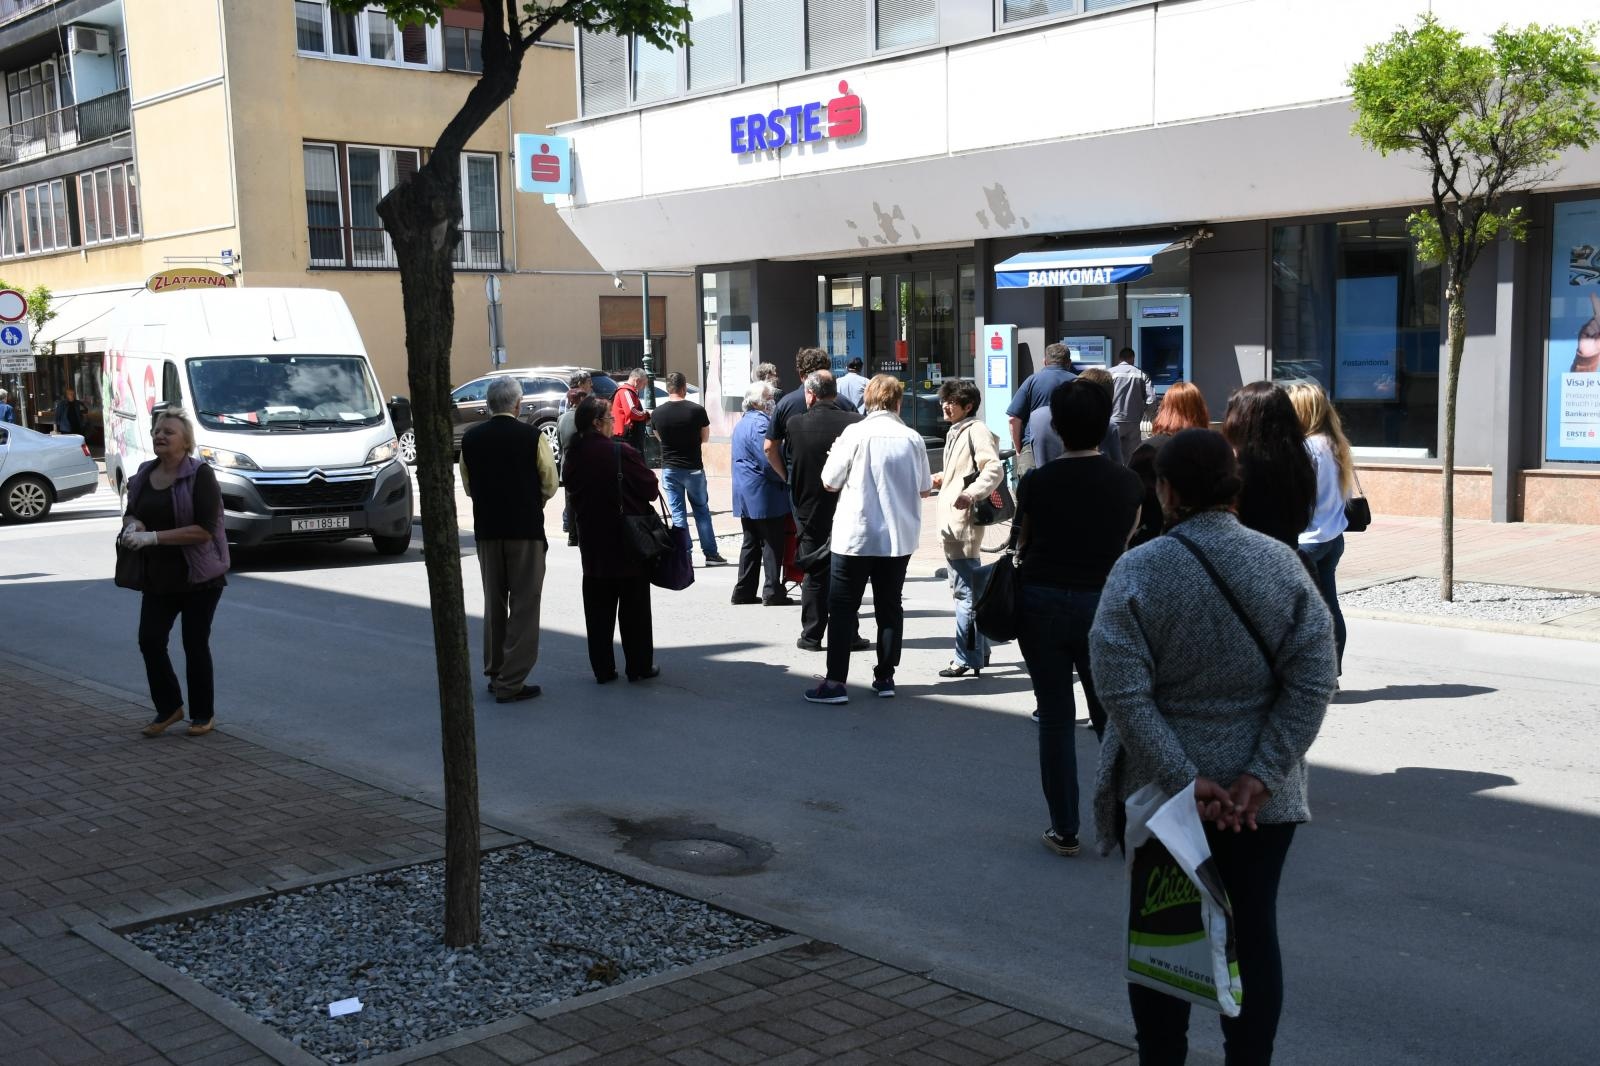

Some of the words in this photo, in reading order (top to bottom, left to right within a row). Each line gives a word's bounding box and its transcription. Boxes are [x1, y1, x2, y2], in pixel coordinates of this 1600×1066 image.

[730, 101, 822, 154] ERSTE
[154, 275, 228, 291] ZLATARNA
[1028, 267, 1115, 287] BANKOMAT
[1566, 378, 1585, 386] Visa
[1586, 378, 1595, 388] je
[297, 520, 309, 530] KT
